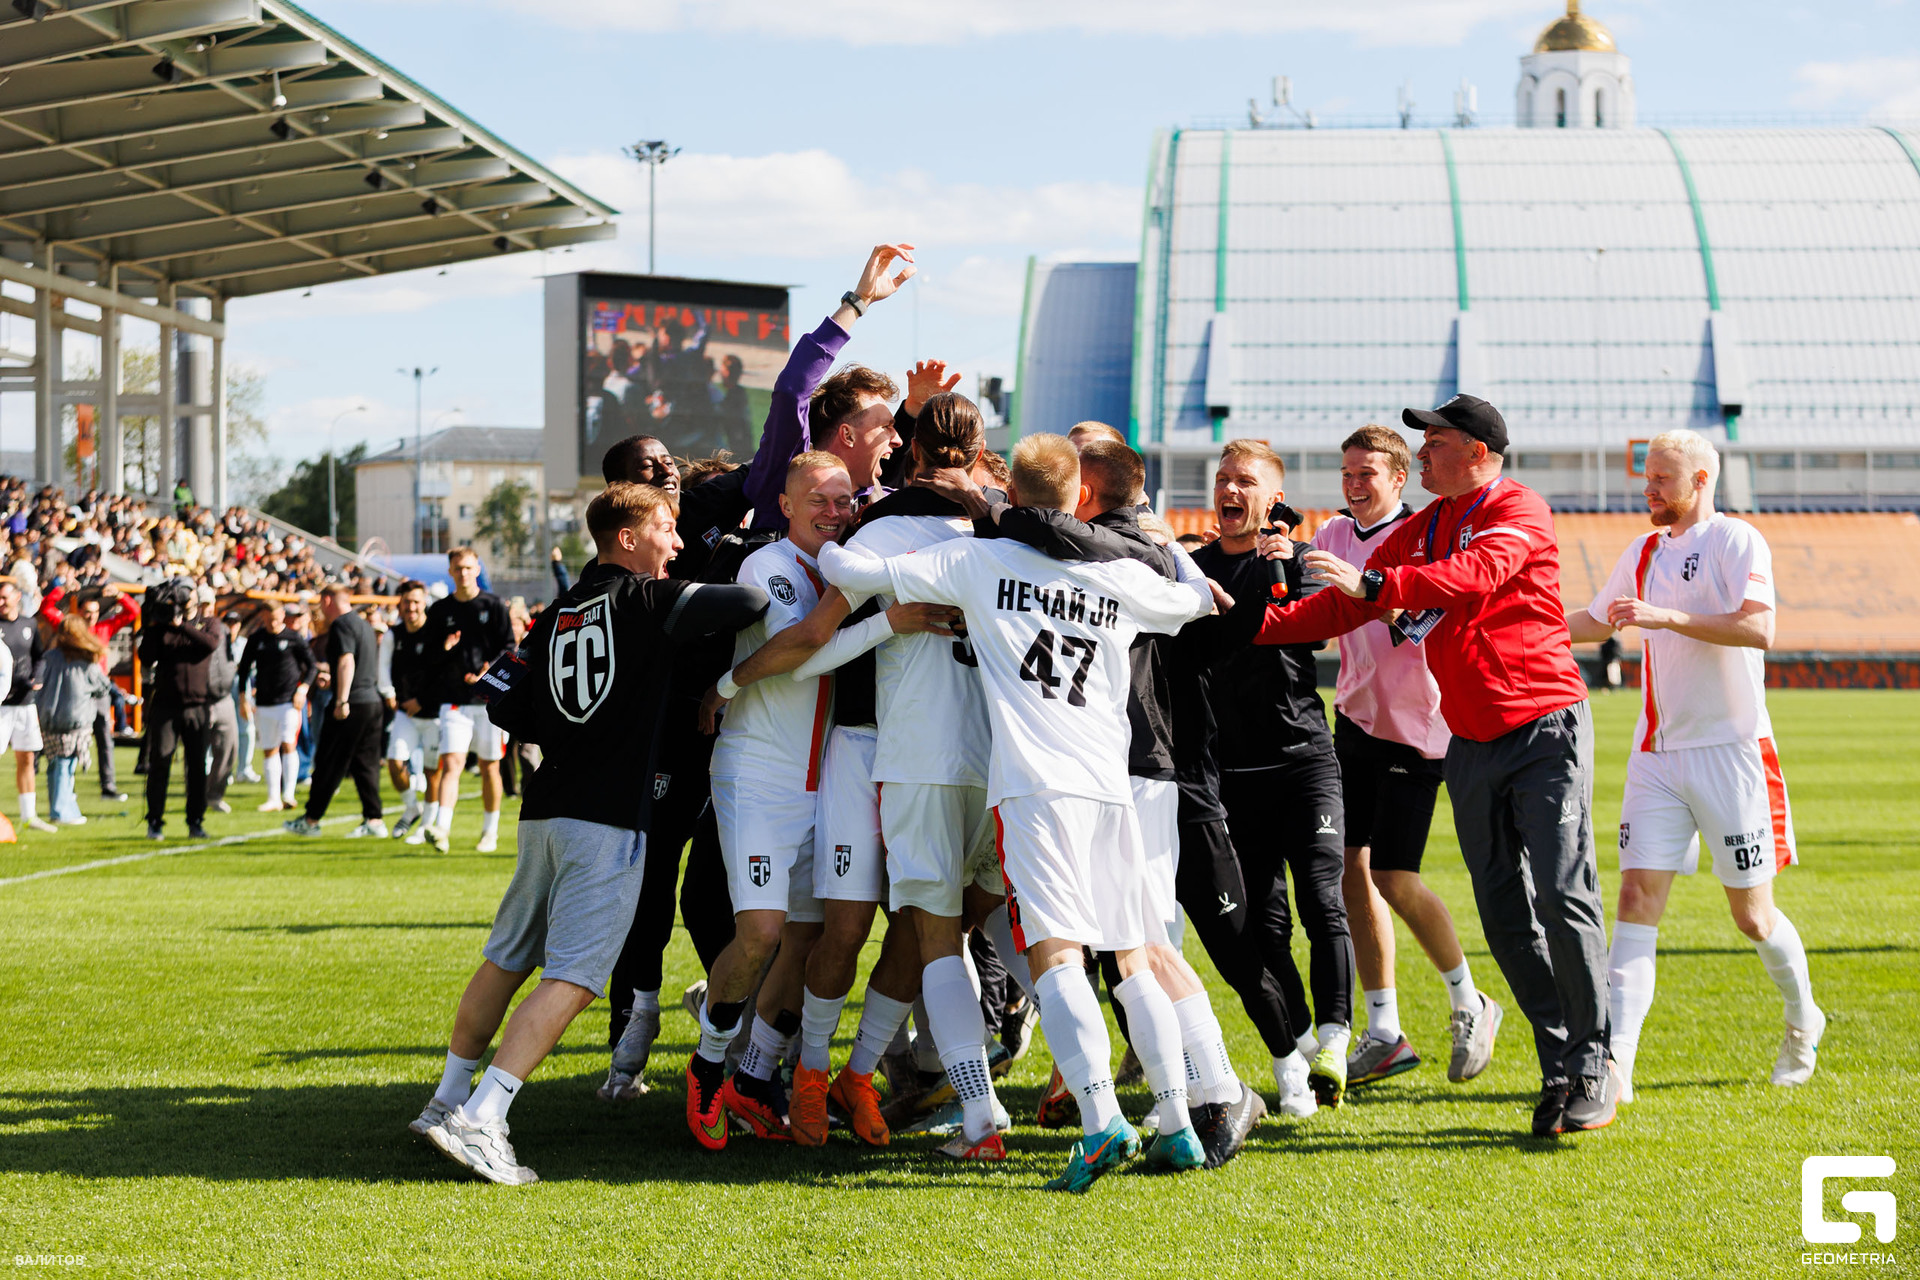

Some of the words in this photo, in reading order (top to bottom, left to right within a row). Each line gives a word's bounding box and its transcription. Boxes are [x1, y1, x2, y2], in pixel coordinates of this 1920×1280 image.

[997, 578, 1086, 624] НЕЧАЙ
[1089, 596, 1120, 630] JR
[554, 624, 606, 711] FC
[1019, 628, 1098, 707] 47
[1724, 832, 1755, 847] BEREZA
[835, 851, 850, 876] FC
[1735, 844, 1763, 871] 92
[750, 861, 770, 886] FC
